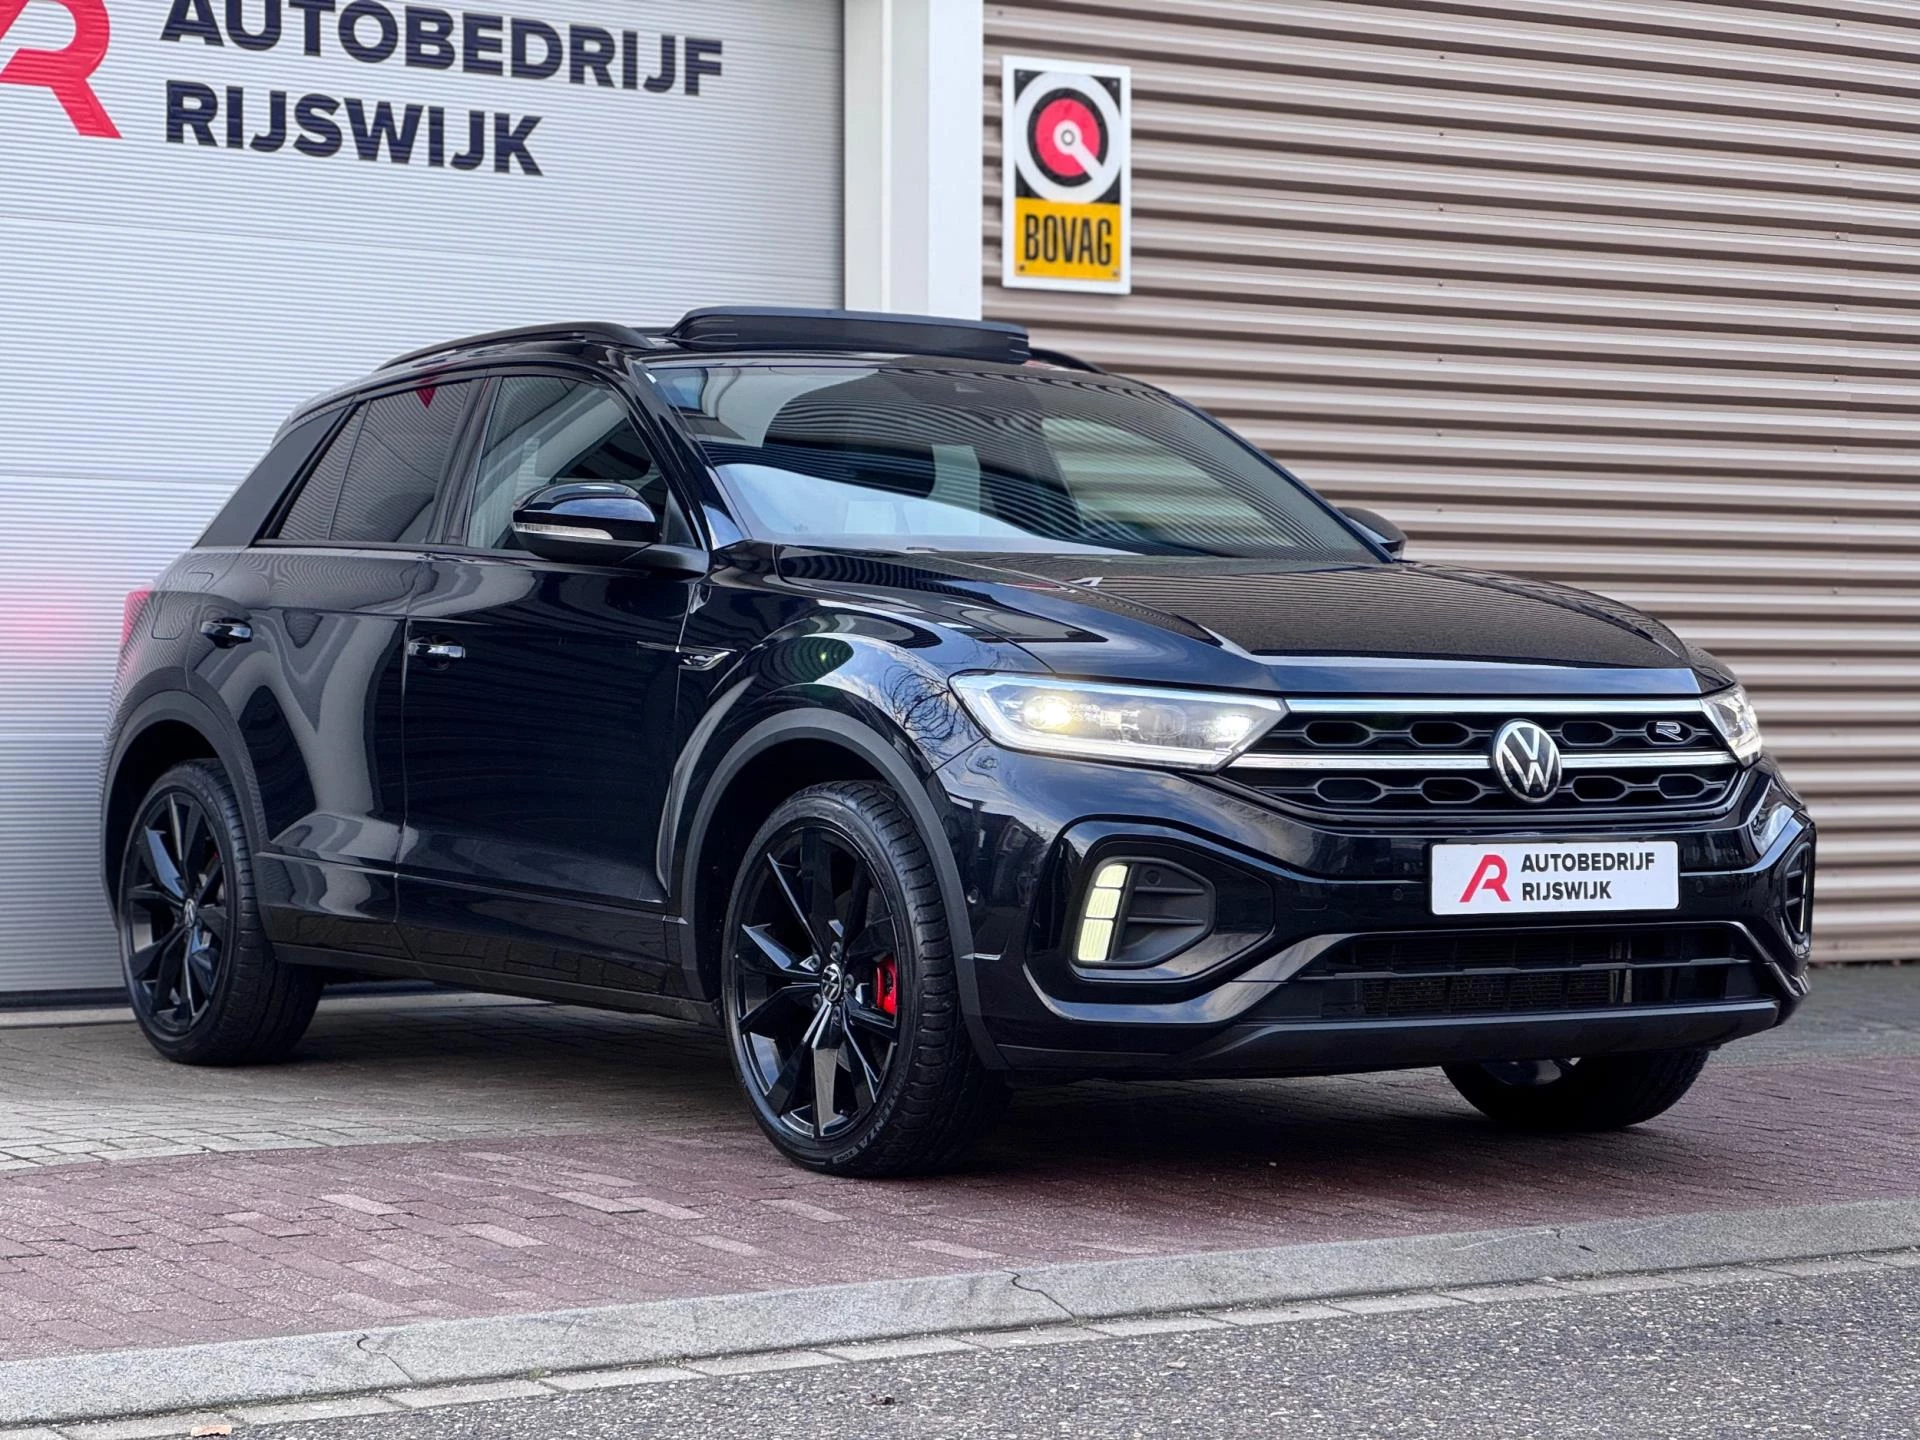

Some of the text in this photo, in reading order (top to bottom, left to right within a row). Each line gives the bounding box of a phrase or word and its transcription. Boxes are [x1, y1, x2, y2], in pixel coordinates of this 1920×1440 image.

[160, 0, 723, 97] AUTOBEDRIJF
[166, 79, 544, 177] RIJSWIJK
[1024, 214, 1112, 266] BOVAG
[1521, 852, 1655, 873] AUTOBEDRIJF
[1522, 881, 1612, 901] RIJSWIJK
